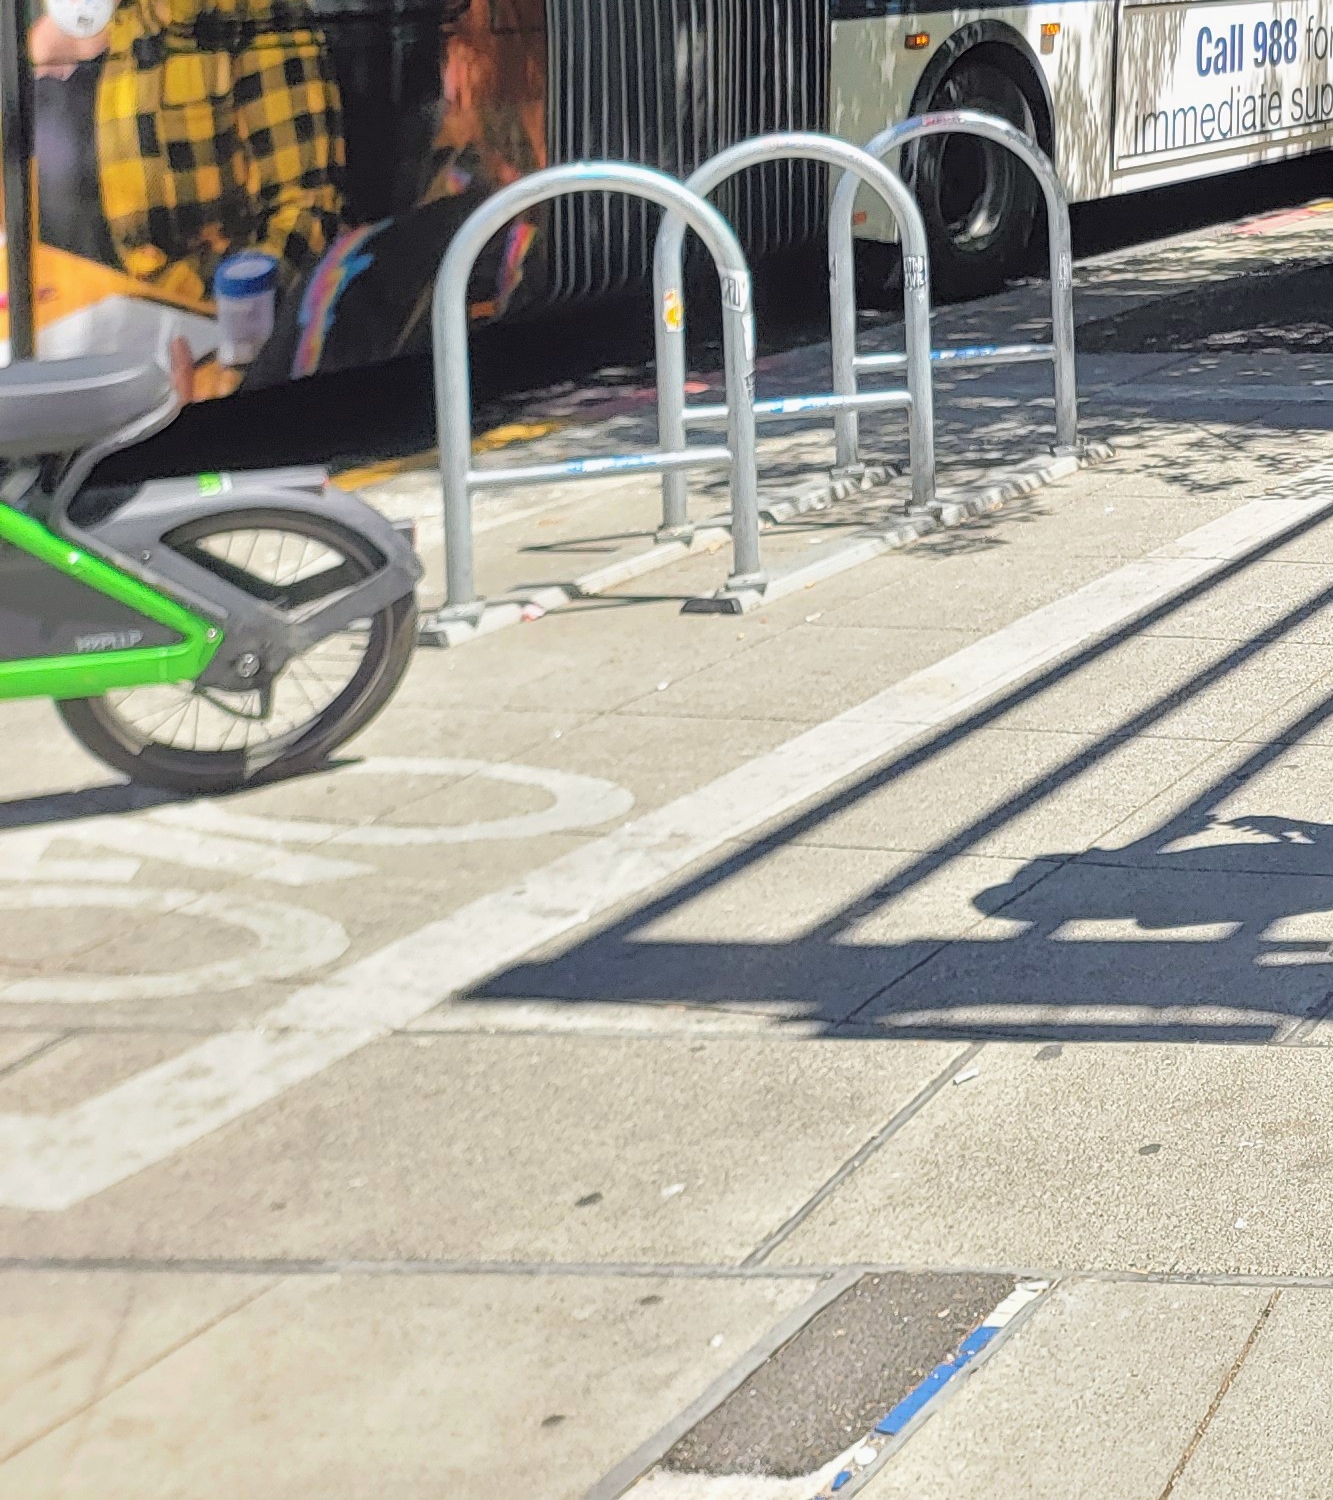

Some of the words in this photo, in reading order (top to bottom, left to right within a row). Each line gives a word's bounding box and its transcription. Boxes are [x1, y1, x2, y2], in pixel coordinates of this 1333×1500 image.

[1196, 23, 1245, 77] Call
[1253, 17, 1297, 68] 988
[1135, 84, 1282, 156] immediate
